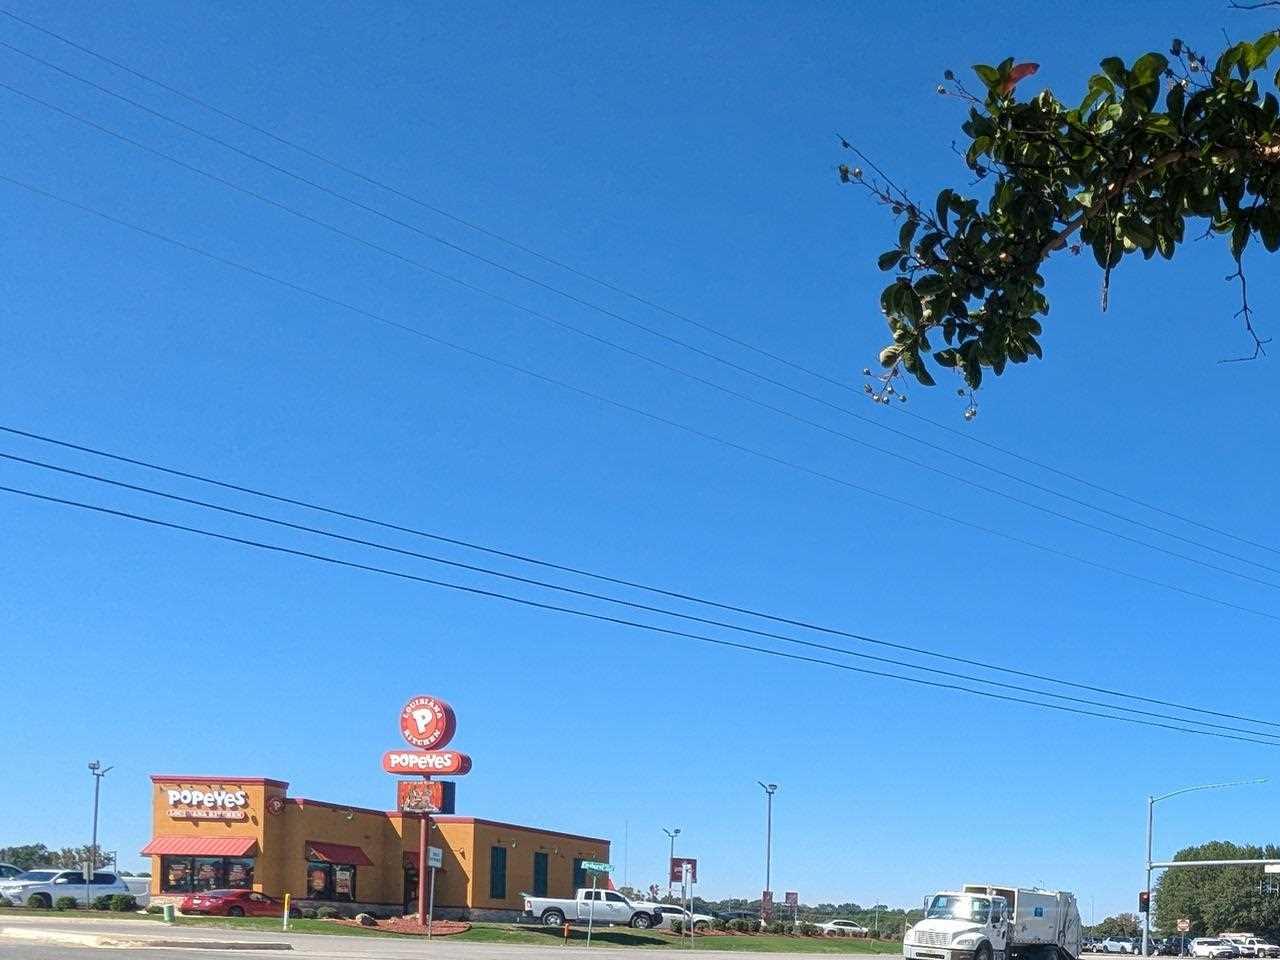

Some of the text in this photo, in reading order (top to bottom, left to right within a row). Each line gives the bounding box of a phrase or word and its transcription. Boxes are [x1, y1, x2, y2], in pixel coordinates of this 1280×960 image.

[403, 699, 442, 718] LOUISIANA
[411, 709, 433, 734] P
[404, 729, 440, 745] KITCHEN
